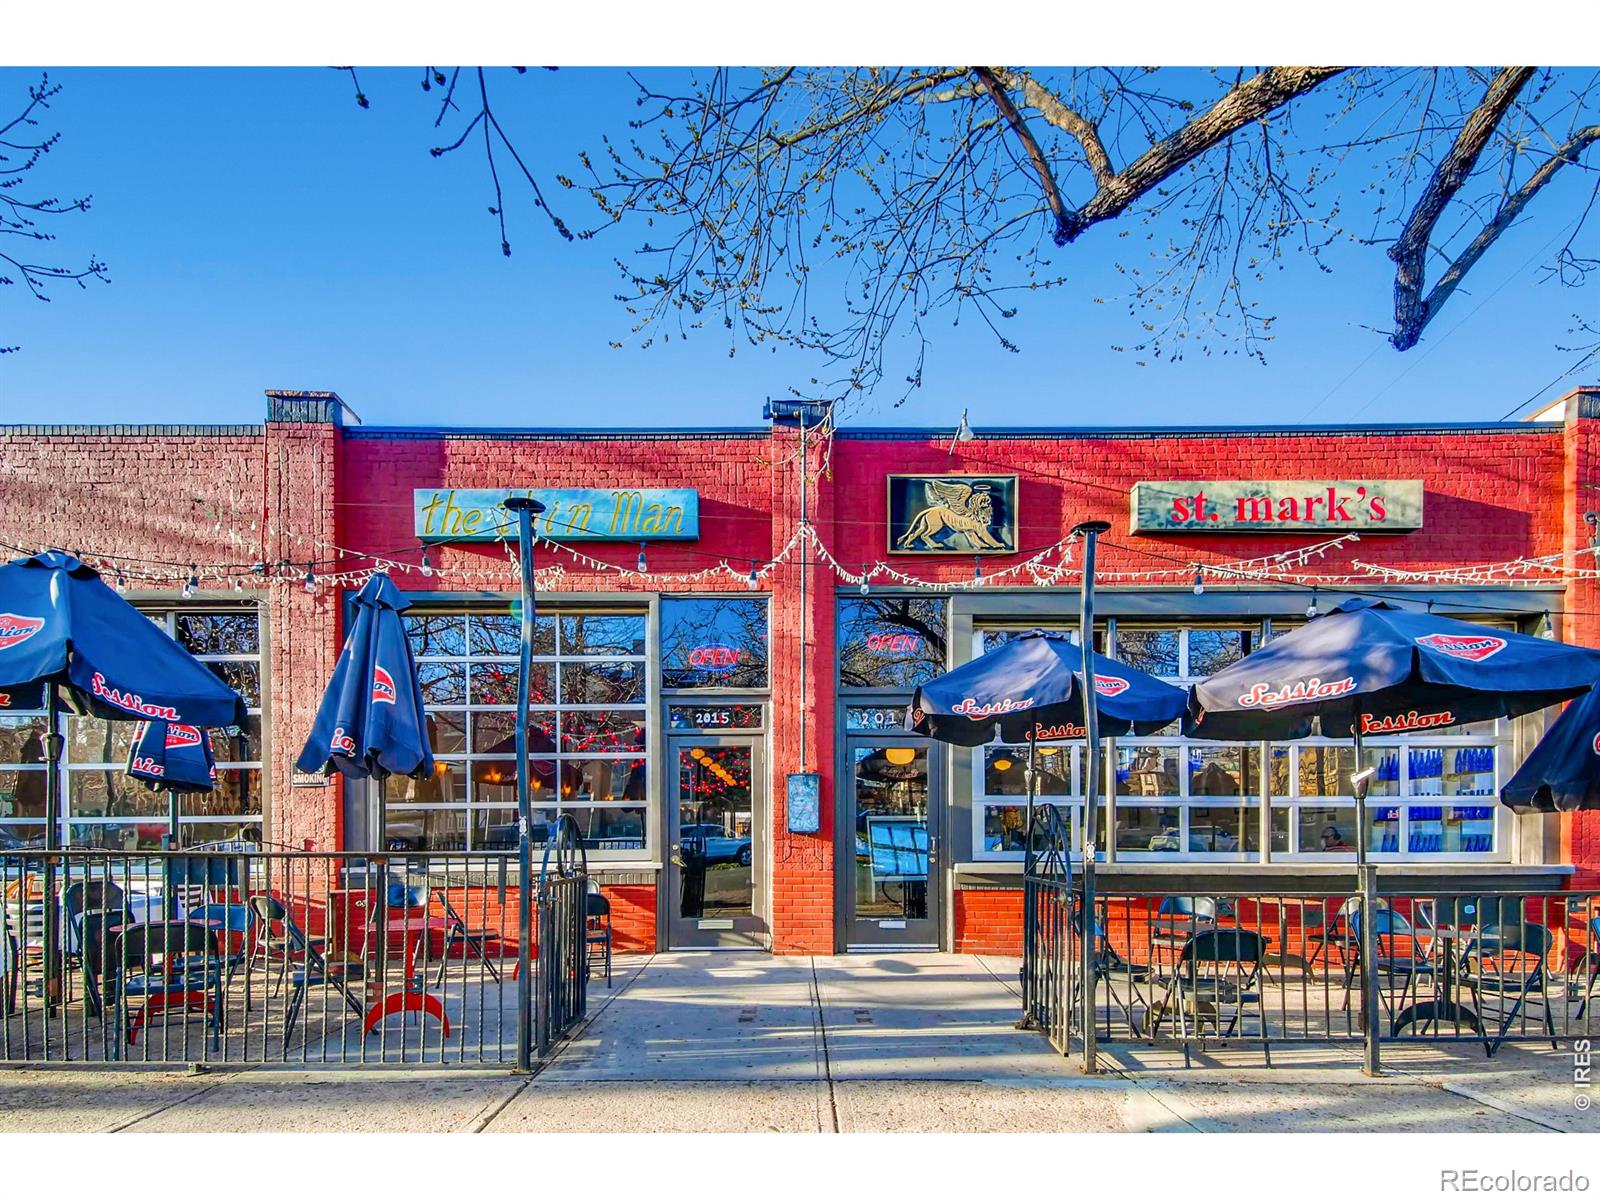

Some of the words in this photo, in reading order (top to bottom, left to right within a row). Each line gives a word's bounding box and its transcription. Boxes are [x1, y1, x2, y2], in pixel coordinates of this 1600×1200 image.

[421, 490, 482, 534] the
[496, 490, 592, 534] tin
[610, 490, 684, 534] Man
[1172, 489, 1219, 522] st.
[1236, 486, 1387, 522] mark's
[867, 634, 919, 652] OPEN
[689, 648, 740, 667] OPEN
[91, 672, 181, 721] Session
[1238, 676, 1358, 707] Session
[695, 711, 730, 724] 2015
[951, 697, 1035, 716] Session
[861, 712, 898, 725] 201
[1350, 710, 1457, 735] Session
